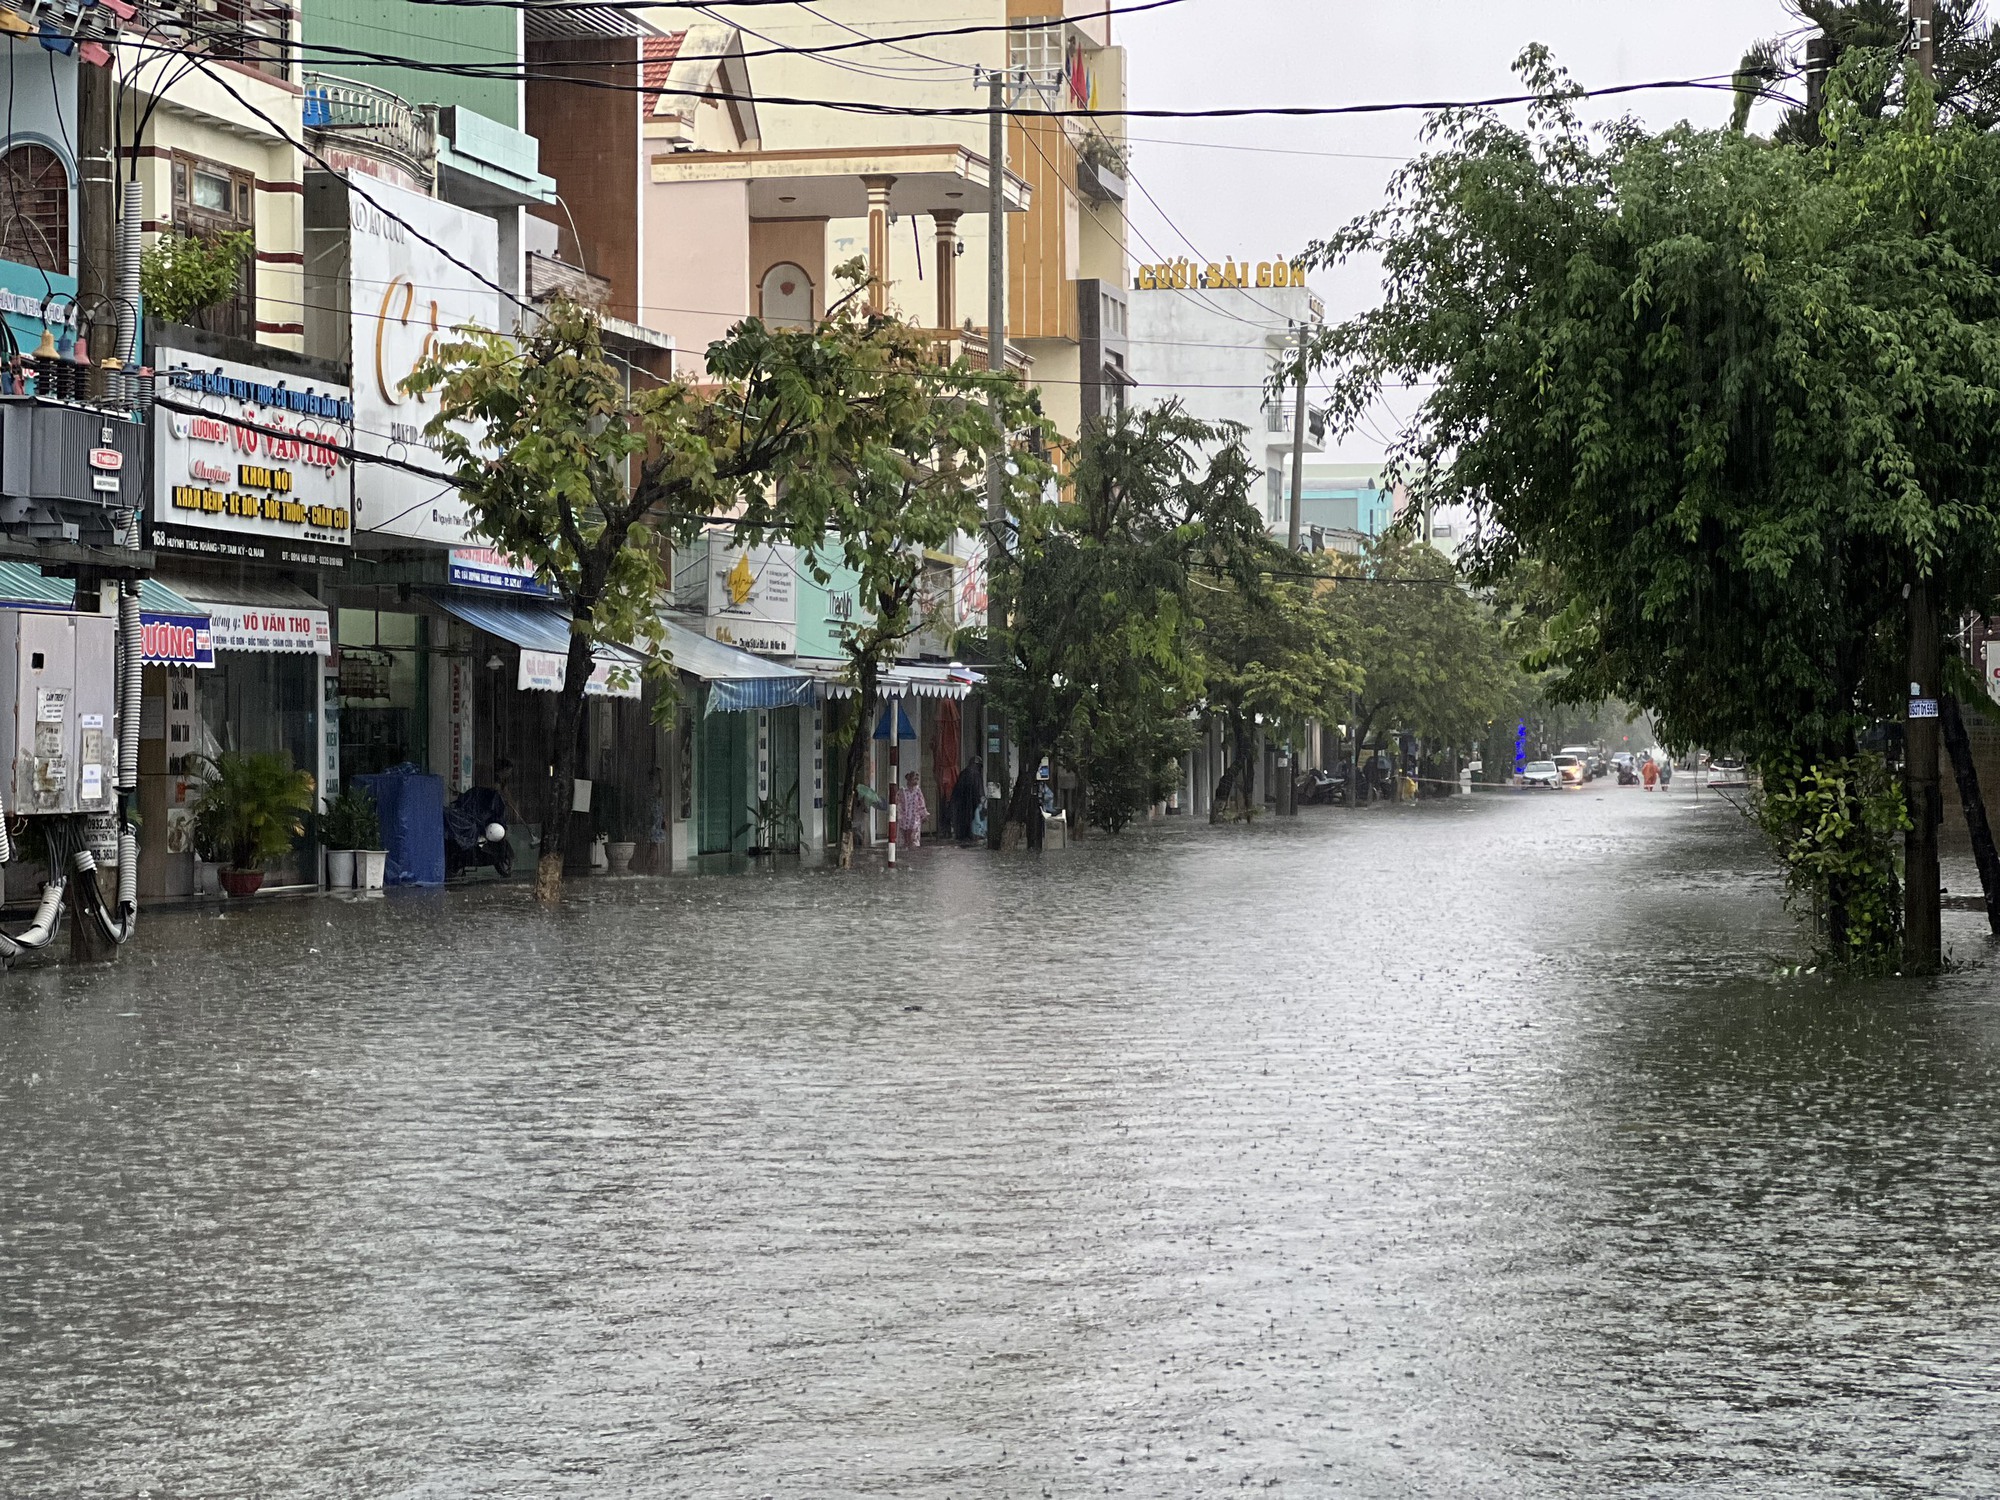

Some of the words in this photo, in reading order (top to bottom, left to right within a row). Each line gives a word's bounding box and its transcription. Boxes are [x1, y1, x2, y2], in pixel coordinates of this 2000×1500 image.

[1138, 255, 1198, 290] CƯỚI
[1206, 254, 1249, 289] SÀI
[1256, 253, 1305, 288] GÒN
[248, 382, 256, 400] Y
[242, 464, 271, 488] KHOA
[274, 467, 292, 494] NỘI
[176, 485, 200, 508] KHÁM
[202, 488, 223, 513] BỆNH
[264, 493, 281, 519] BỐC
[152, 530, 166, 546] 168
[167, 536, 185, 549] HUỲNH
[185, 538, 199, 550] THÚC
[199, 539, 217, 553] KHÁNG
[243, 612, 258, 631] VÕ
[262, 613, 285, 632] VĂN
[289, 617, 310, 637] THỌ
